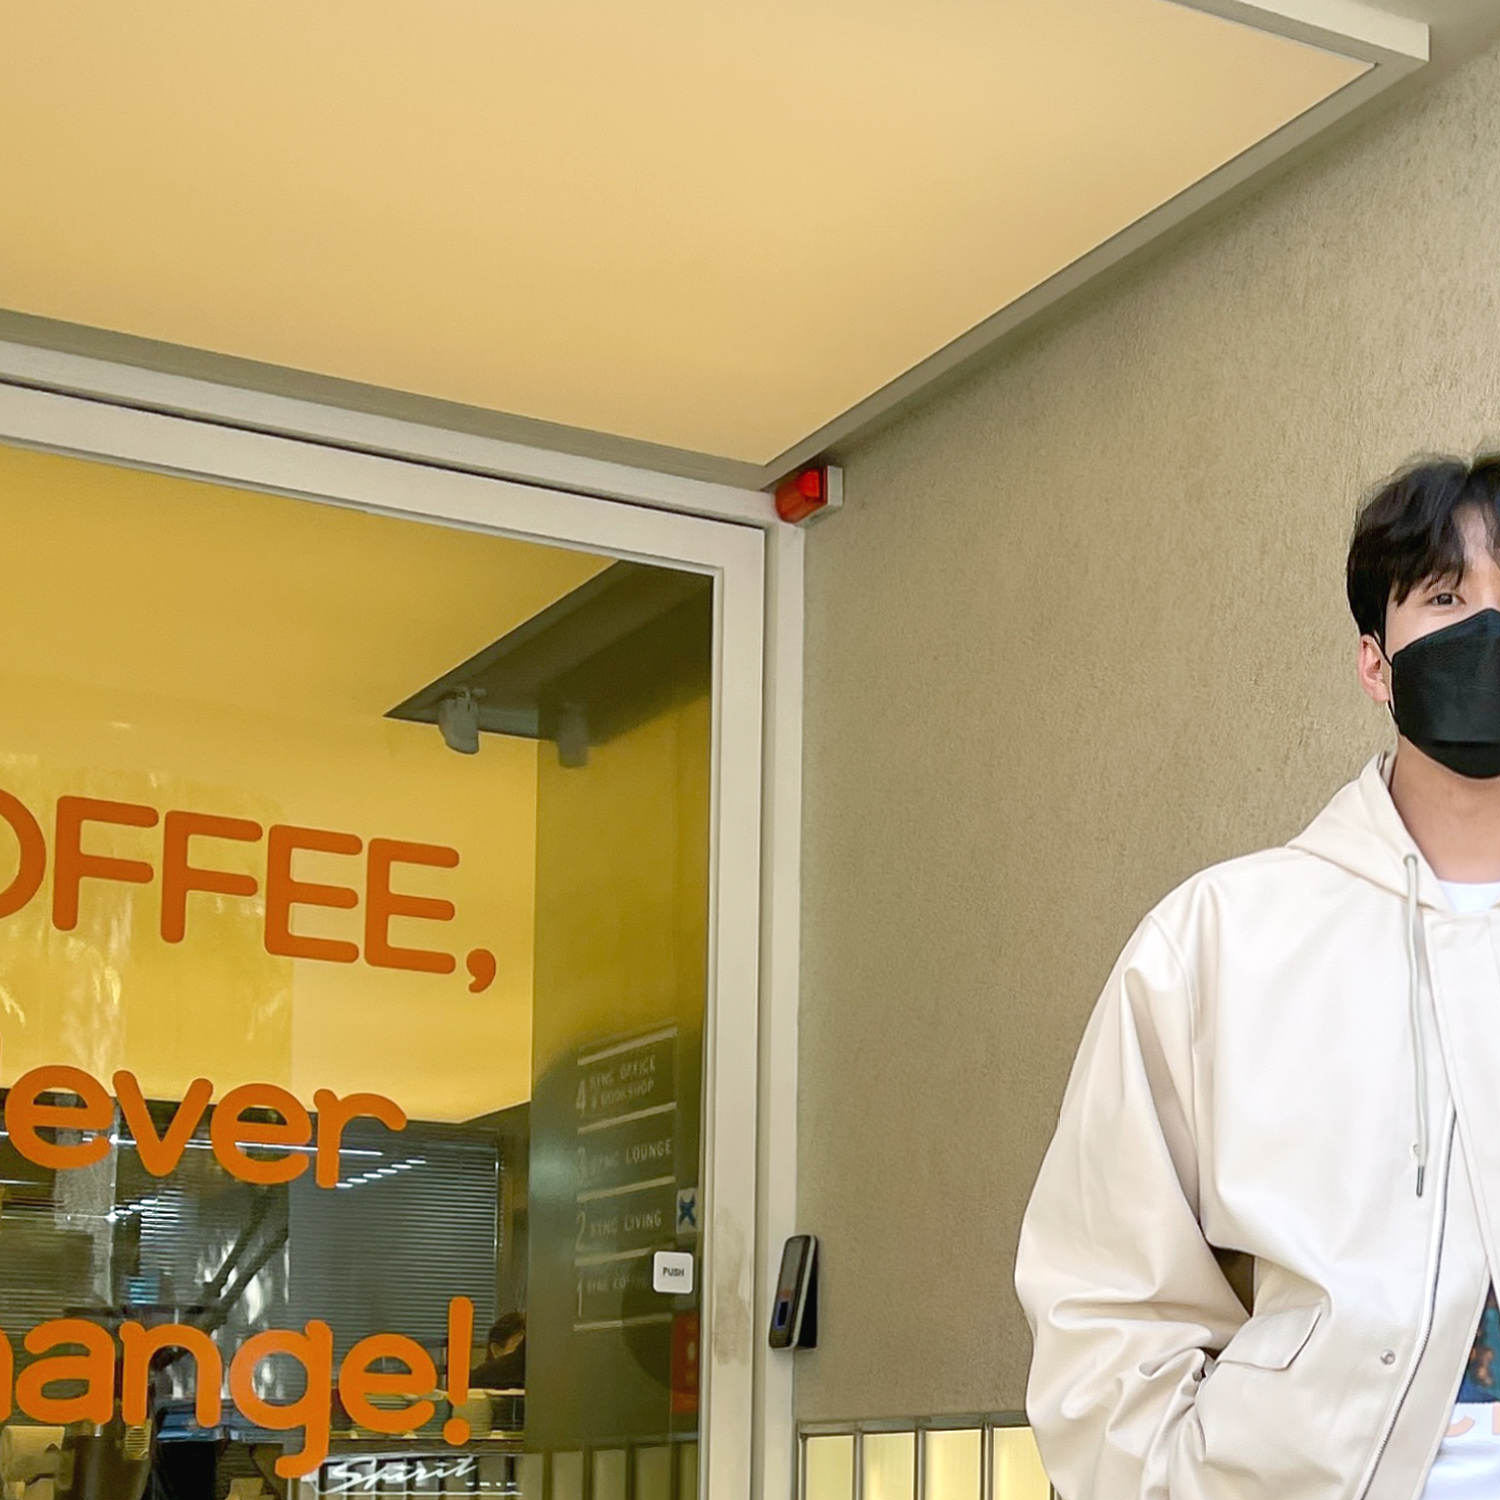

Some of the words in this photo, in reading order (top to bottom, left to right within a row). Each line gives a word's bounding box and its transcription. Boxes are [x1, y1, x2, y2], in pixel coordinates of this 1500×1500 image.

[4, 1064, 408, 1189] ever
[625, 1138, 673, 1165] LOUNGE
[624, 1210, 663, 1232] LIVING
[662, 1266, 685, 1278] PUSH
[0, 1296, 474, 1480] ange!
